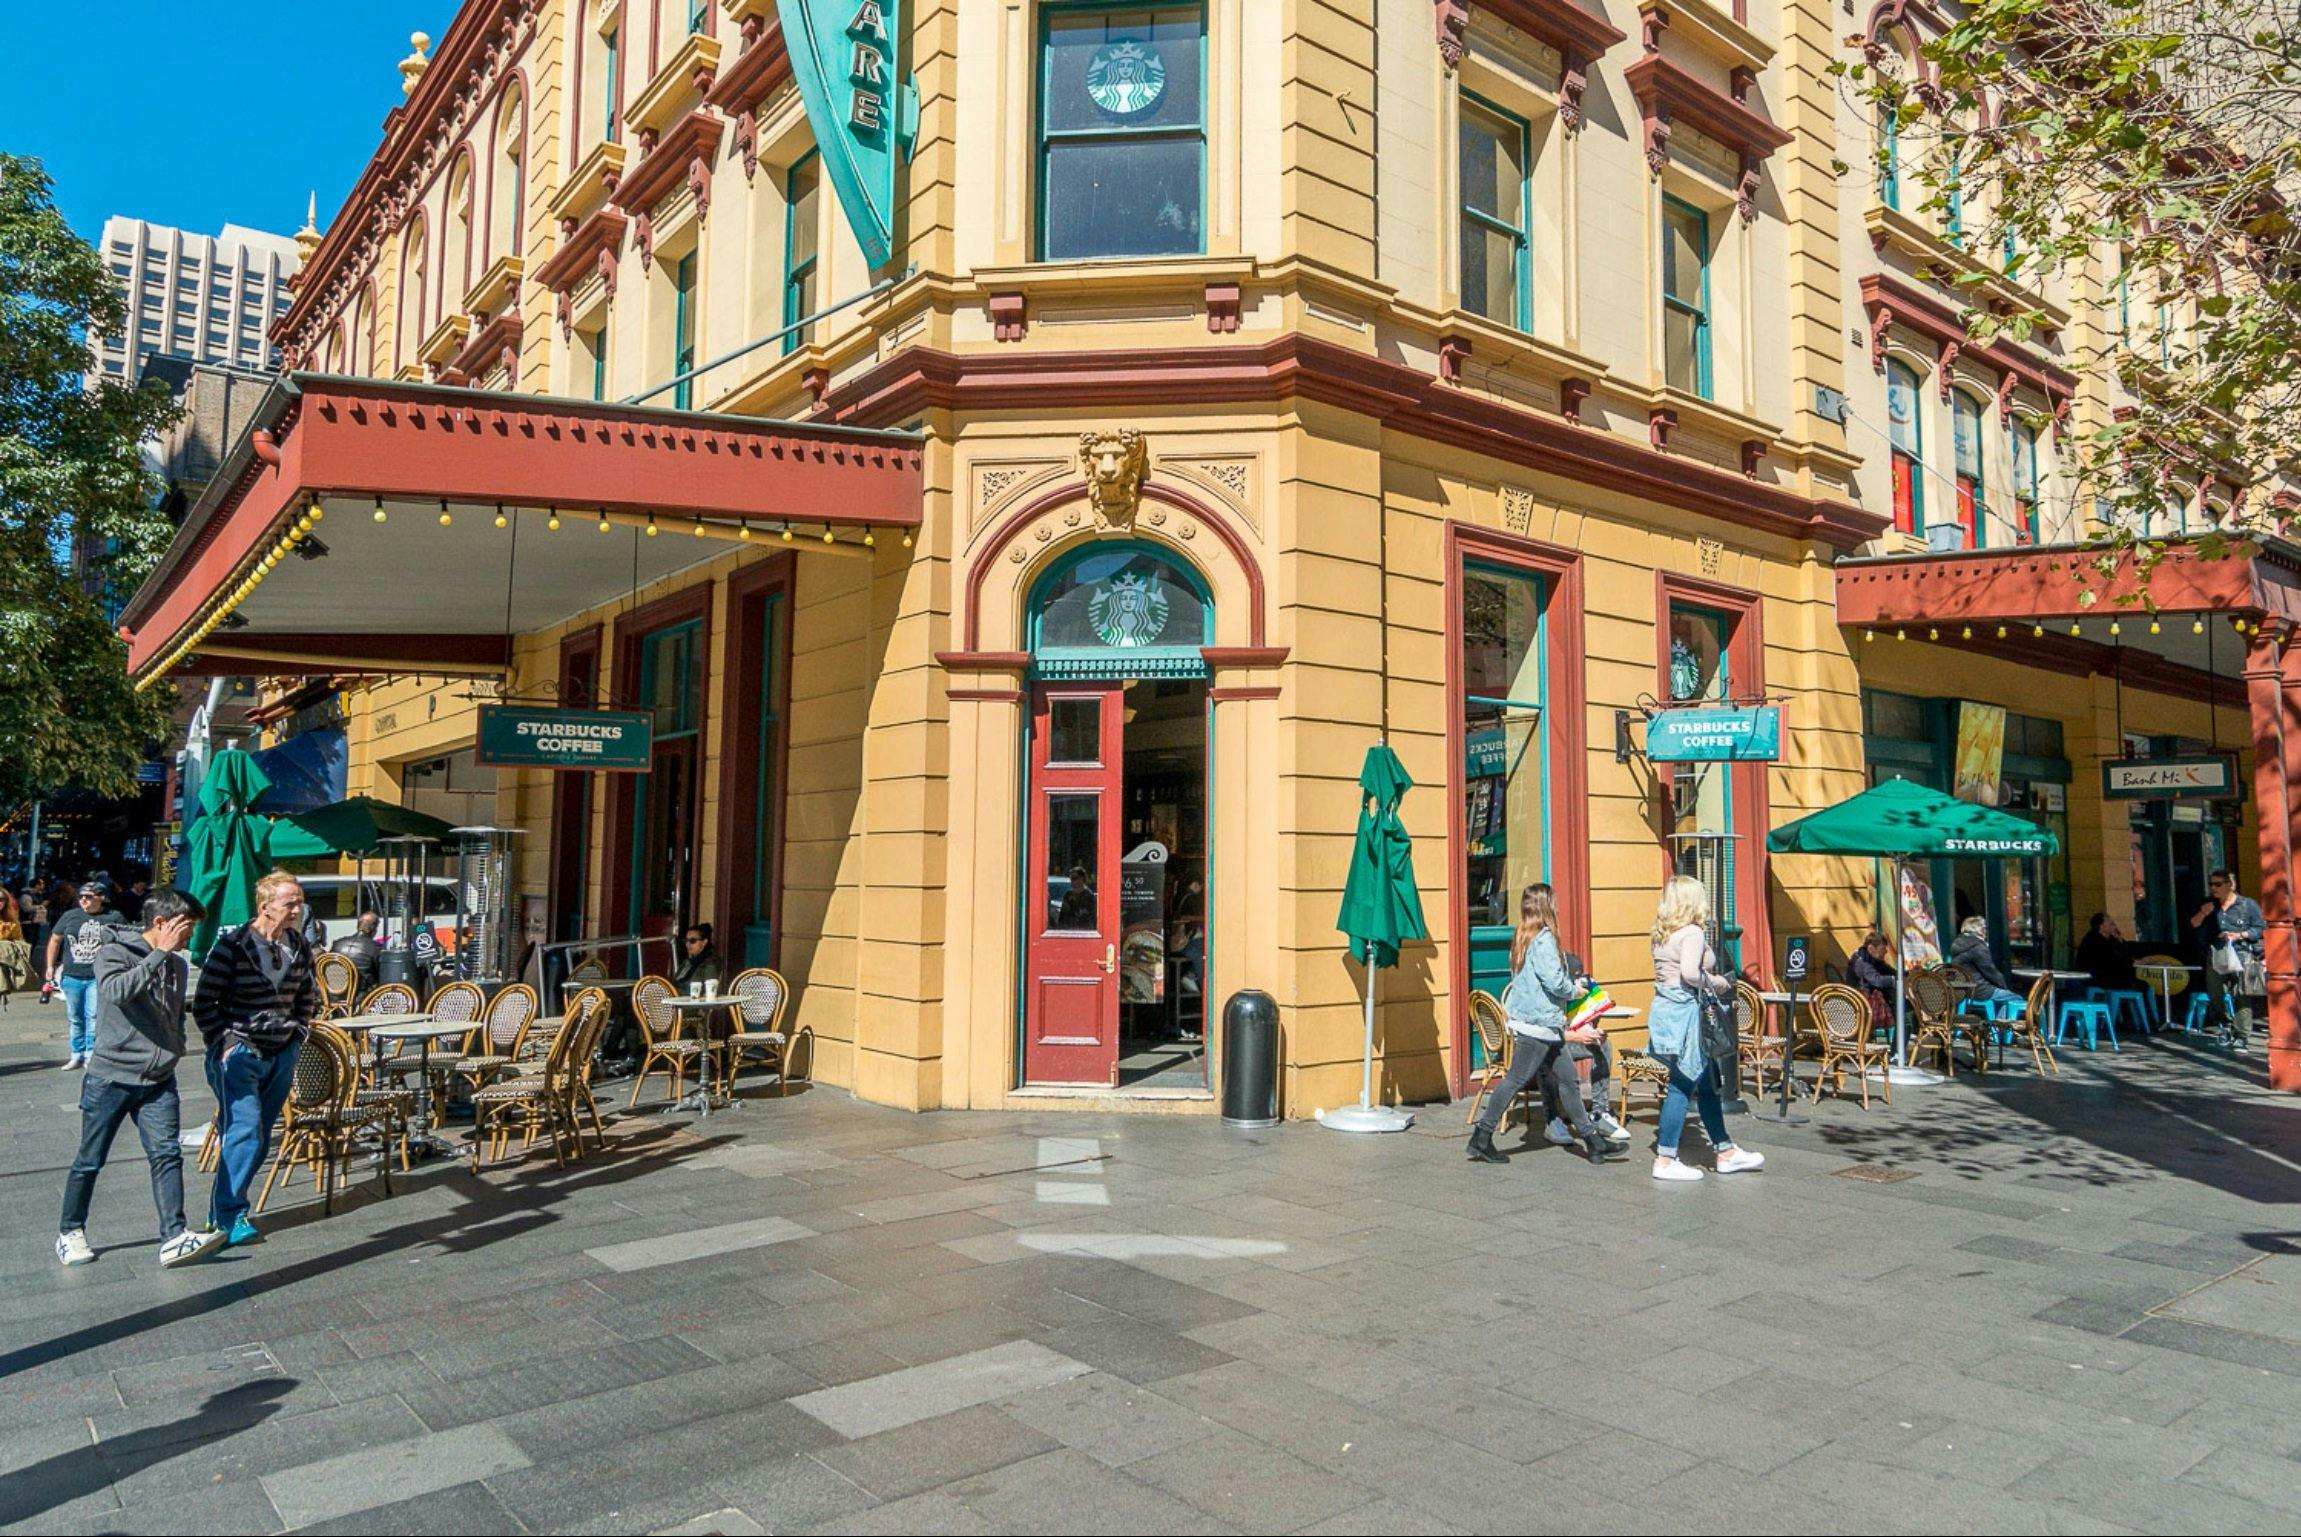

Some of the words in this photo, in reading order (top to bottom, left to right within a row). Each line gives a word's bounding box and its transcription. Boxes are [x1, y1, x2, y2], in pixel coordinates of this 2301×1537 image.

[516, 722, 623, 739] STARBUCKS
[1668, 721, 1751, 735] STARBUCKS
[536, 737, 603, 753] COFFEE
[1682, 735, 1733, 748] COFFEE
[2161, 770, 2181, 784] Mi
[1945, 839, 2042, 851] STARBUCKS
